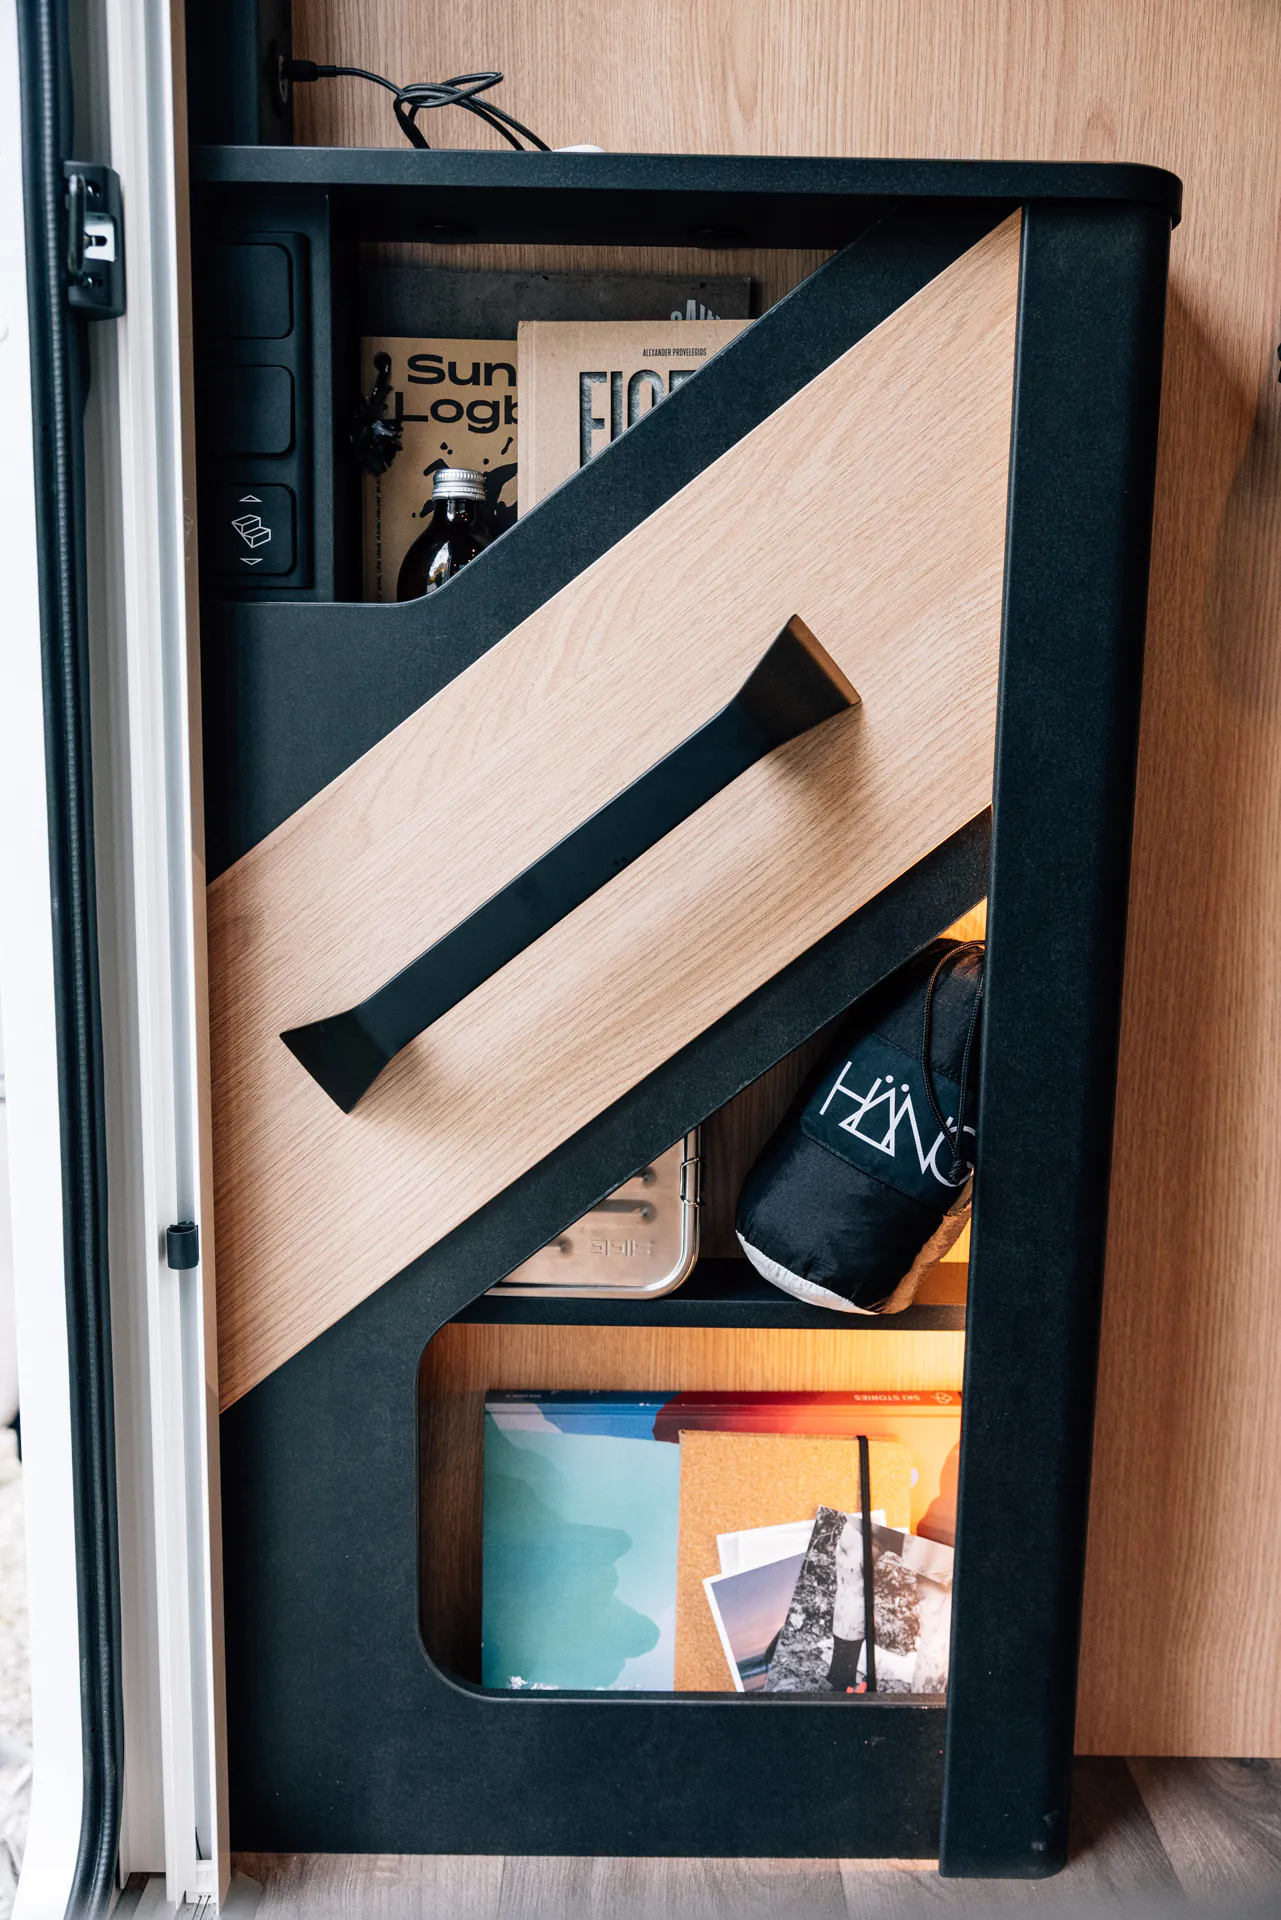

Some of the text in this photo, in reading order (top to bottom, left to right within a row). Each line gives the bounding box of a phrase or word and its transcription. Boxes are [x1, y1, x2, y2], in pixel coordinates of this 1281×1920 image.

[643, 347, 707, 357] ALEXANDER PROVELEGIOS
[407, 354, 517, 387] Sun
[579, 369, 698, 469] FIO
